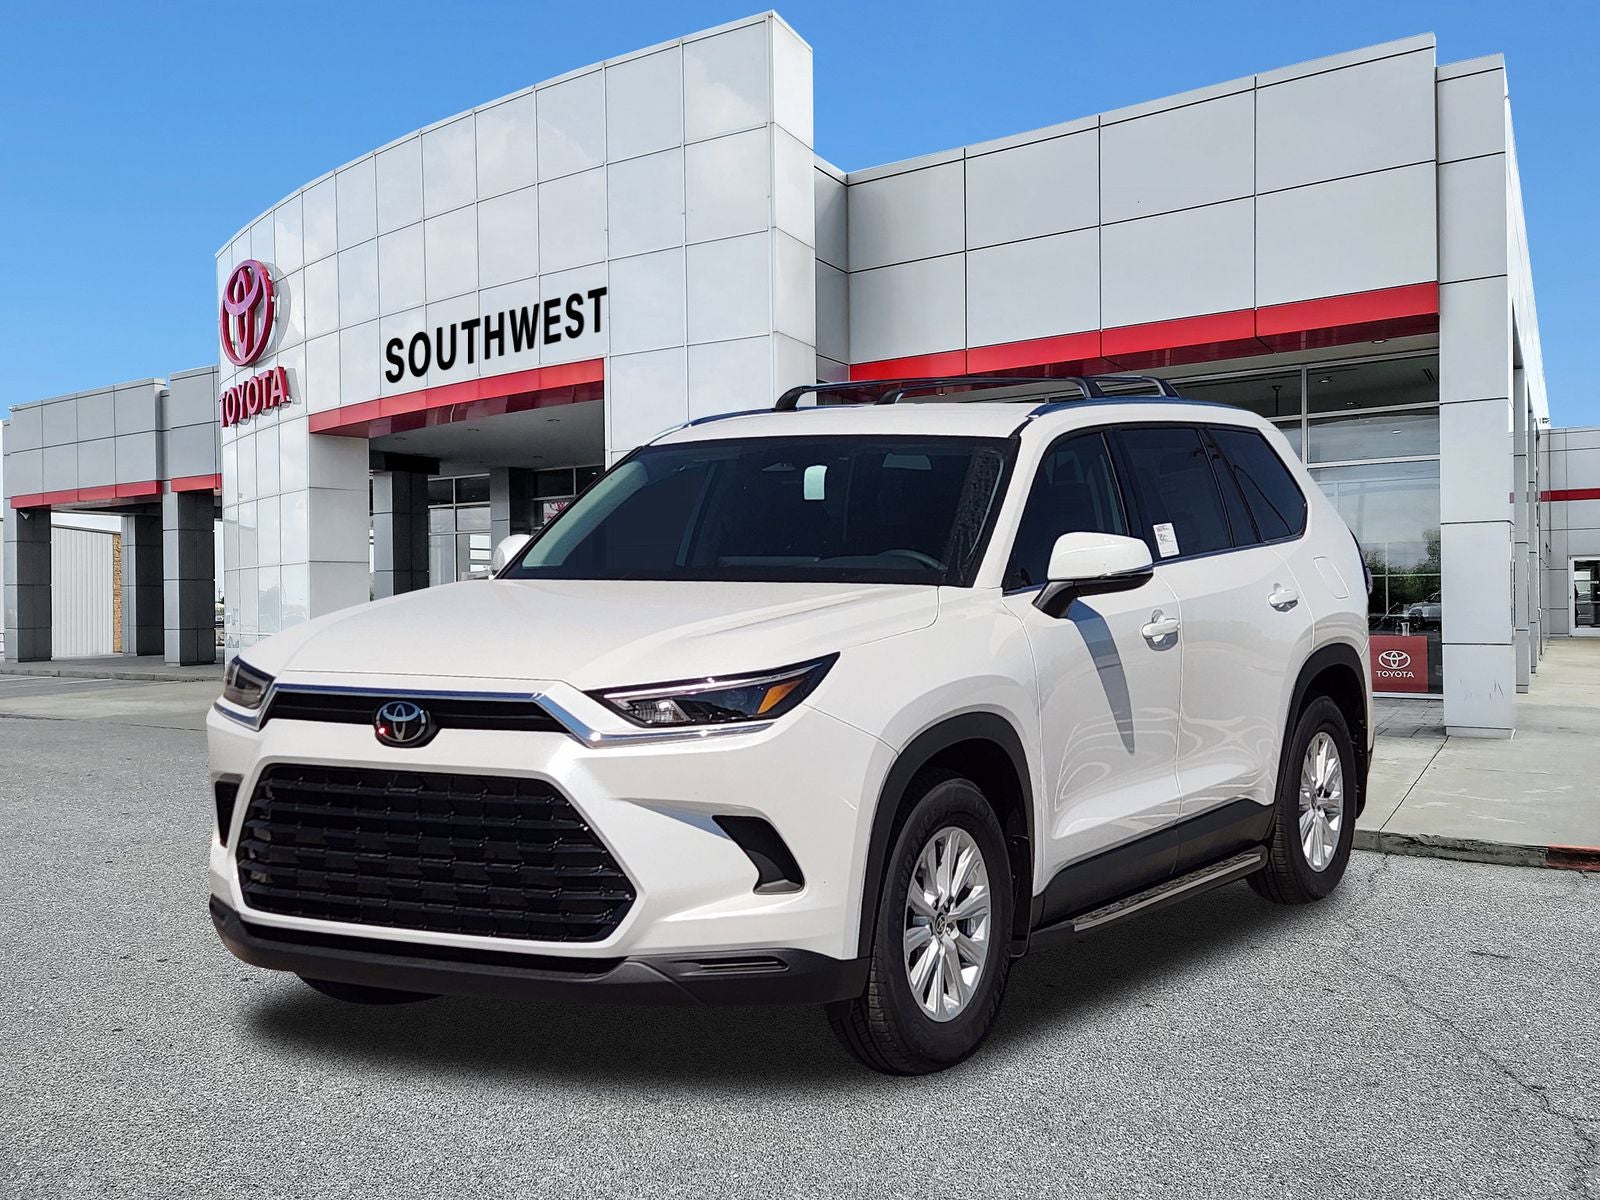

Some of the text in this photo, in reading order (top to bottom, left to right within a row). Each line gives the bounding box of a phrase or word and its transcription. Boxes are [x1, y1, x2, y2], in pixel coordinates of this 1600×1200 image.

[385, 286, 608, 384] SOUTHWEST
[219, 365, 290, 427] TOYOTA
[1376, 670, 1414, 678] TOYOTA
